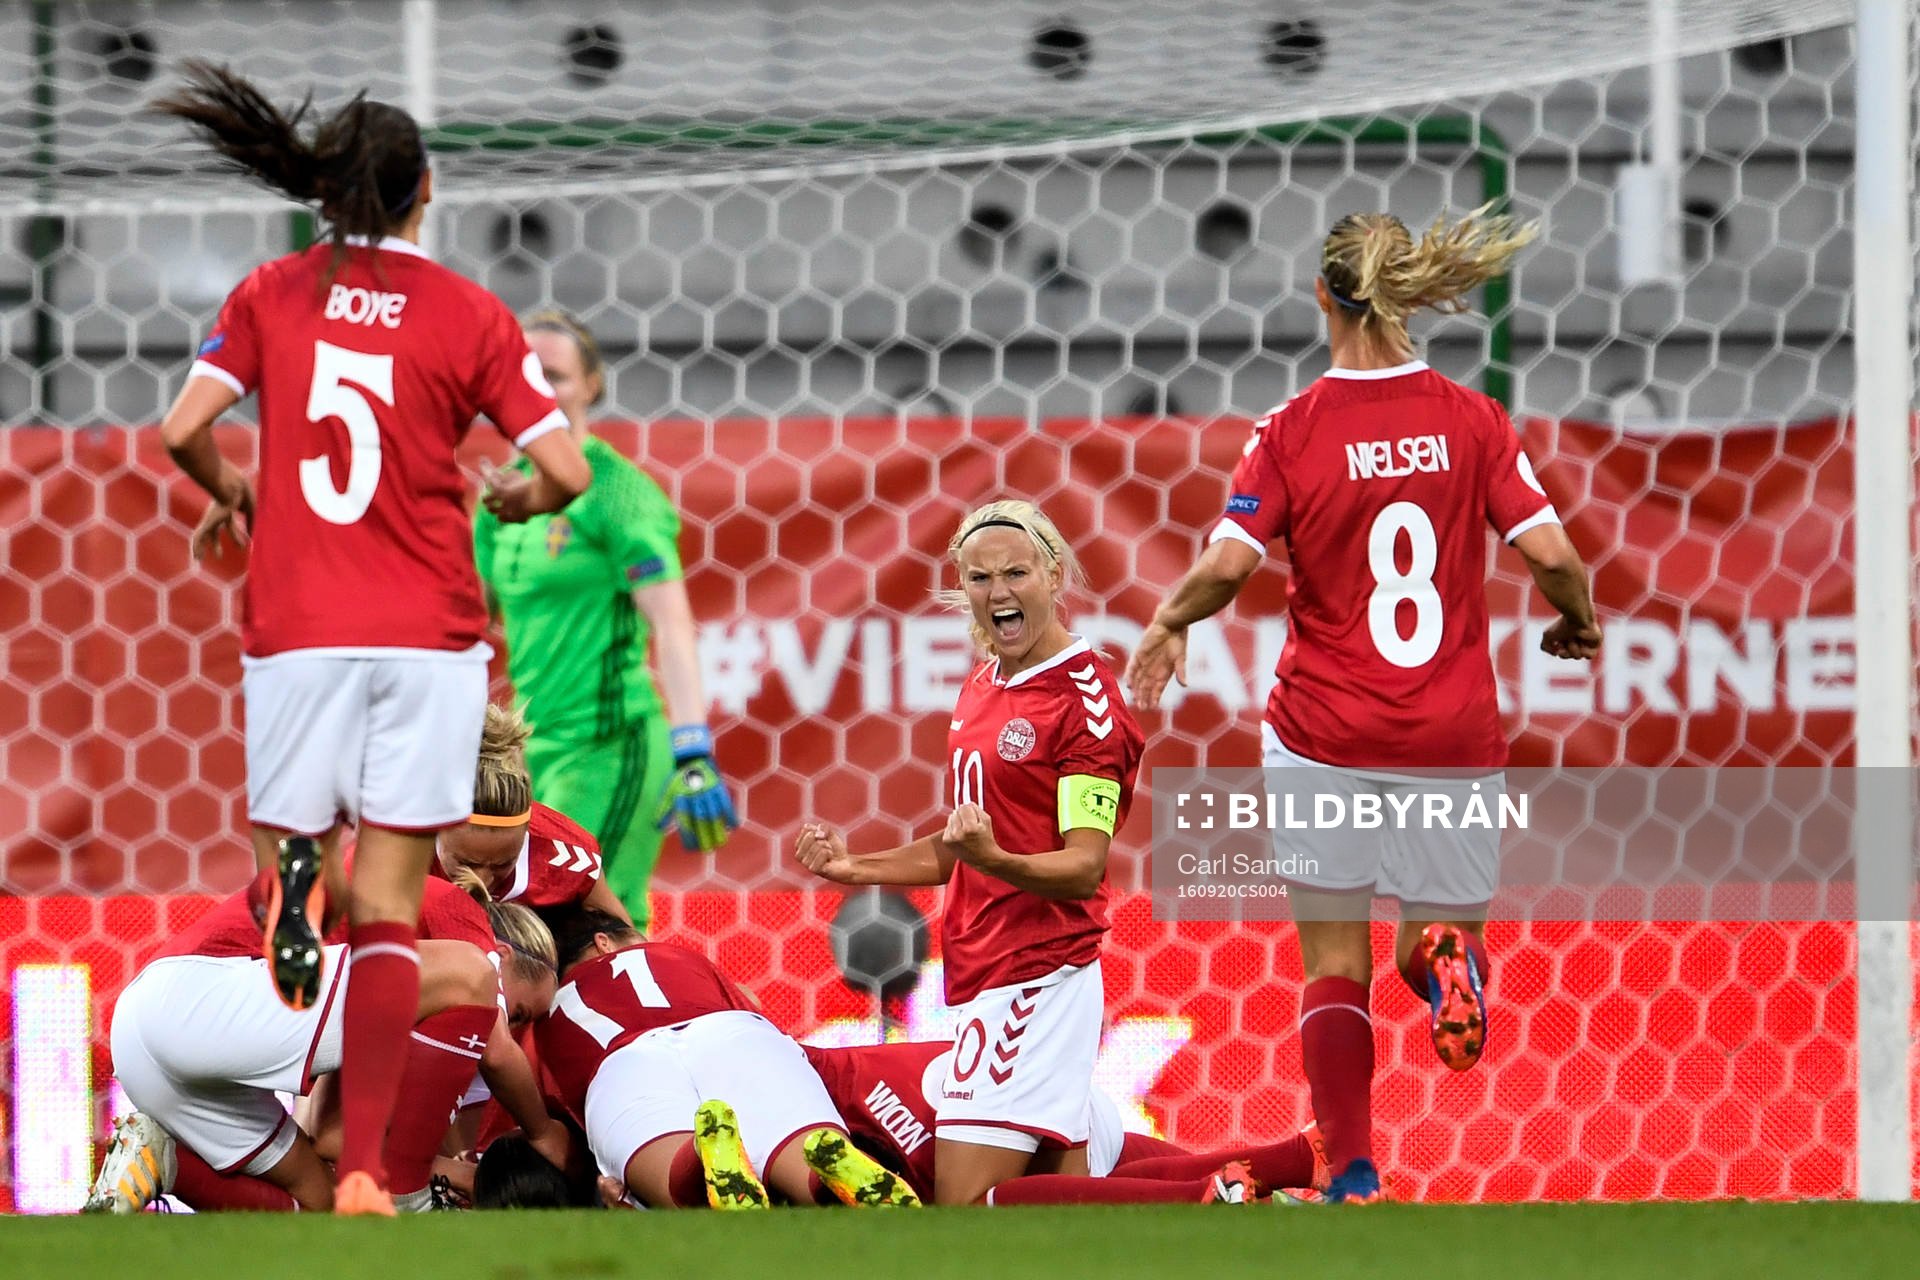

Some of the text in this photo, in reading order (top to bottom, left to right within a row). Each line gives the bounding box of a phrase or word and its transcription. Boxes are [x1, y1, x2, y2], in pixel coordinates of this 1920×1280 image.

[299, 340, 395, 525] 5
[1345, 434, 1450, 480] NIELSEN
[1368, 501, 1444, 668] 8
[953, 747, 984, 810] 10
[549, 948, 672, 1051] 11
[954, 1017, 986, 1082] 0
[943, 1089, 974, 1100] ummel
